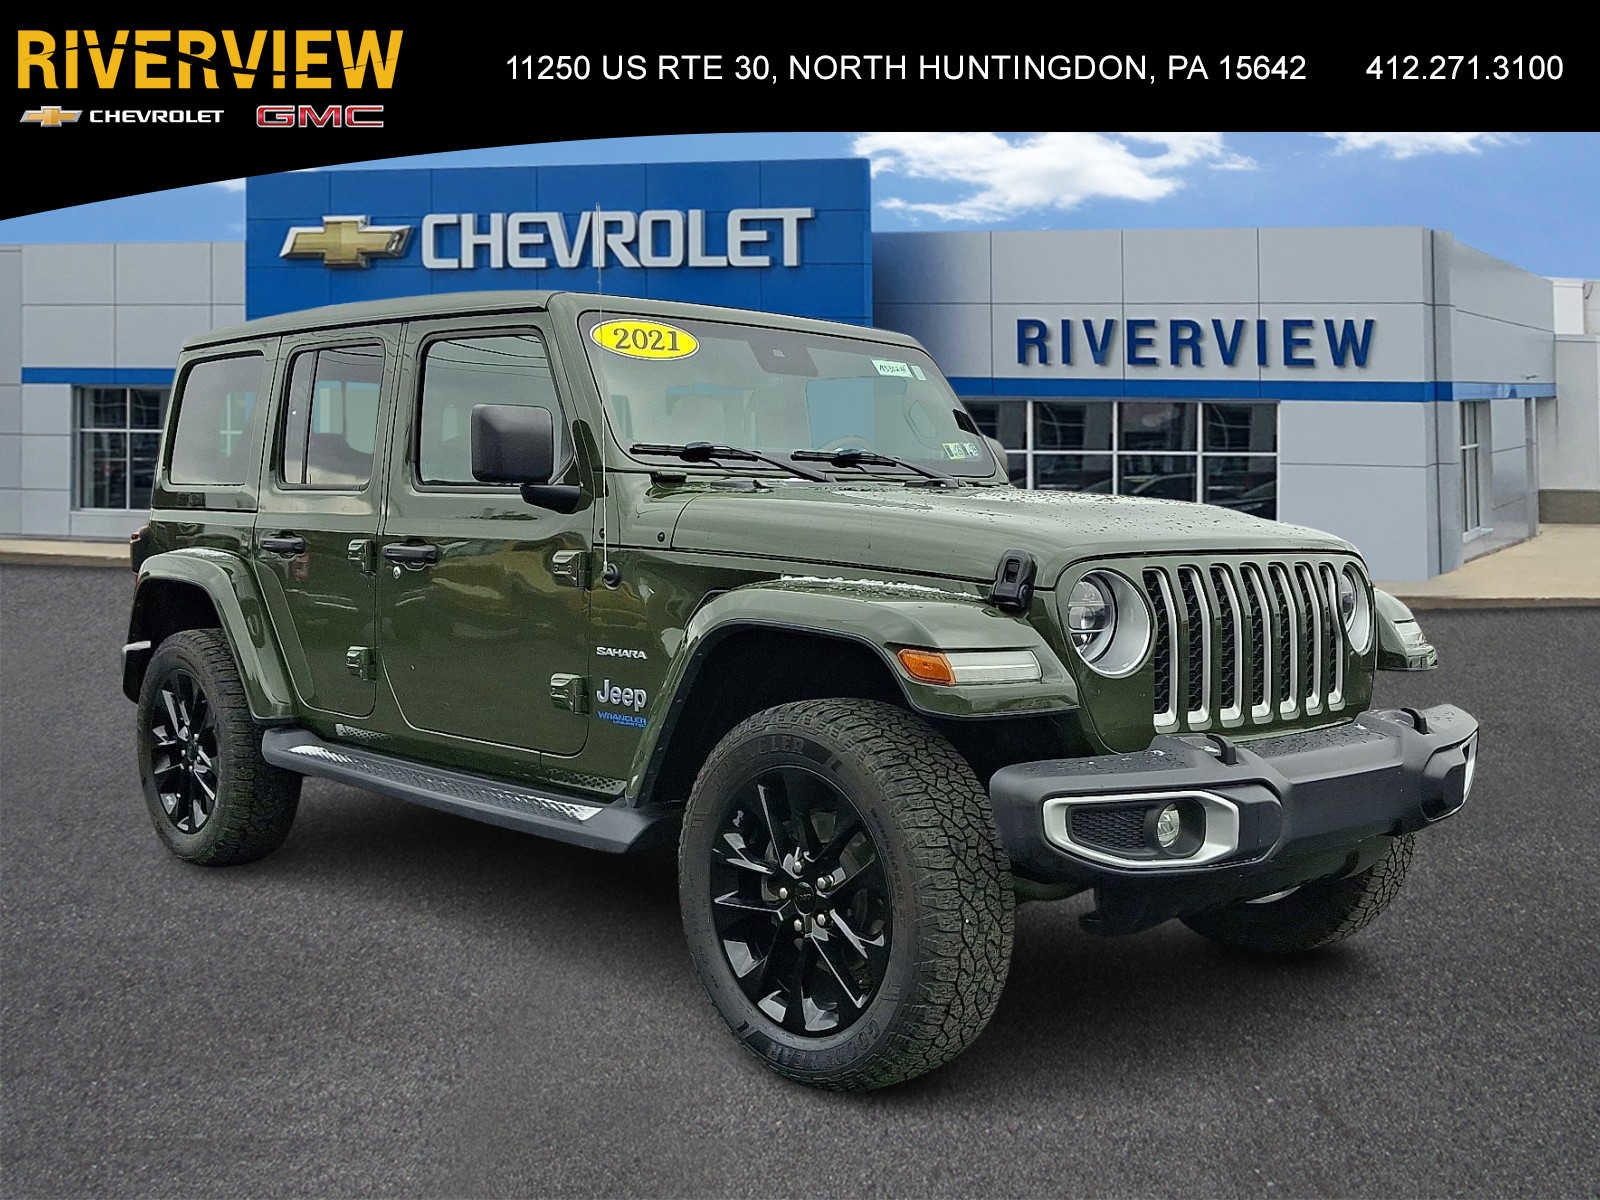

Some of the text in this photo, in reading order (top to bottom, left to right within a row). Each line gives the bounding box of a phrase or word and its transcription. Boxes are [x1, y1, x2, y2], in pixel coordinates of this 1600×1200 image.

[422, 207, 812, 269] CHEVROLET
[613, 327, 681, 351] 2021
[1017, 318, 1375, 367] RIVERVIEW
[596, 646, 648, 660] SAHARA
[596, 679, 647, 712] Jeep
[597, 711, 647, 725] WRANGLER
